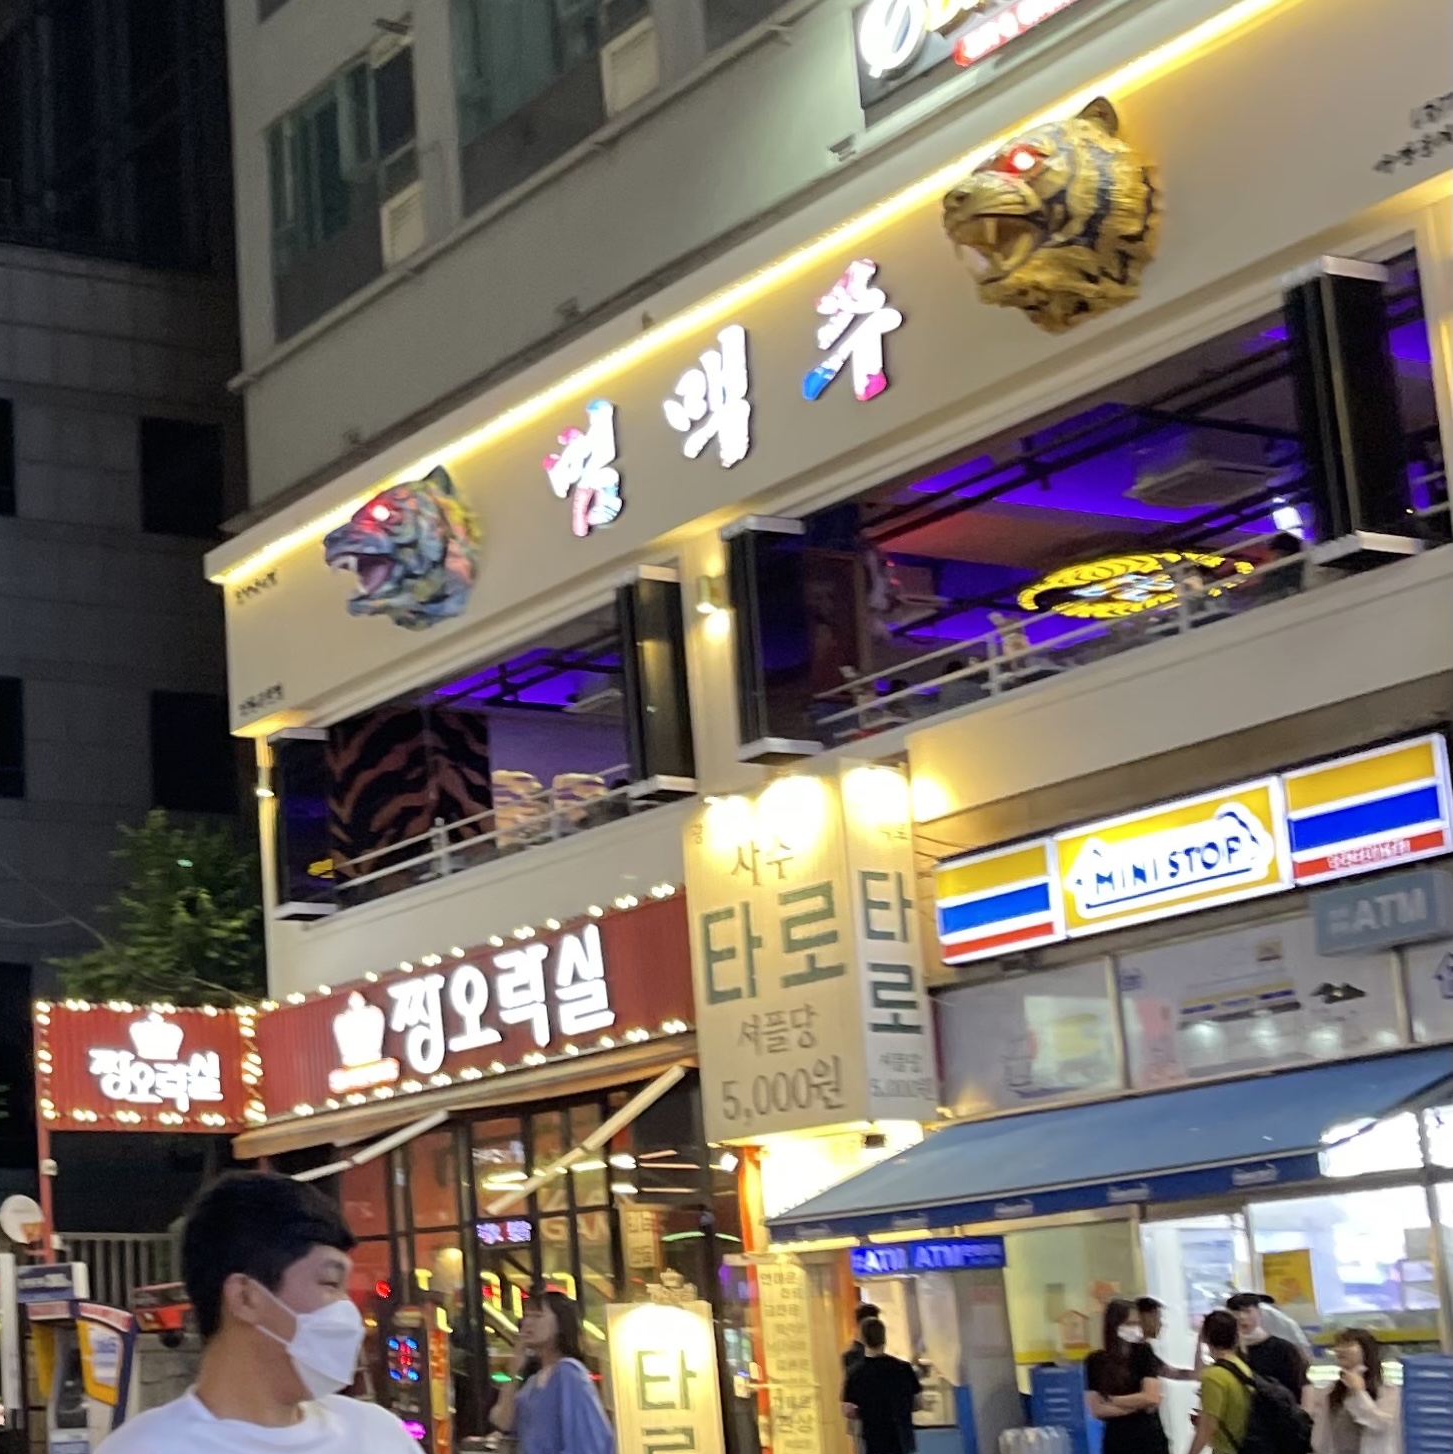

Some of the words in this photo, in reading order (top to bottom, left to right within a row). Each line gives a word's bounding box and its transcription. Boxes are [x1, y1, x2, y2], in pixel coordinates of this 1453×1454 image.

[700, 880, 848, 1006] 타로
[858, 869, 924, 1035] 타로
[1352, 888, 1428, 930] ATM
[721, 1055, 845, 1126] 5,000원
